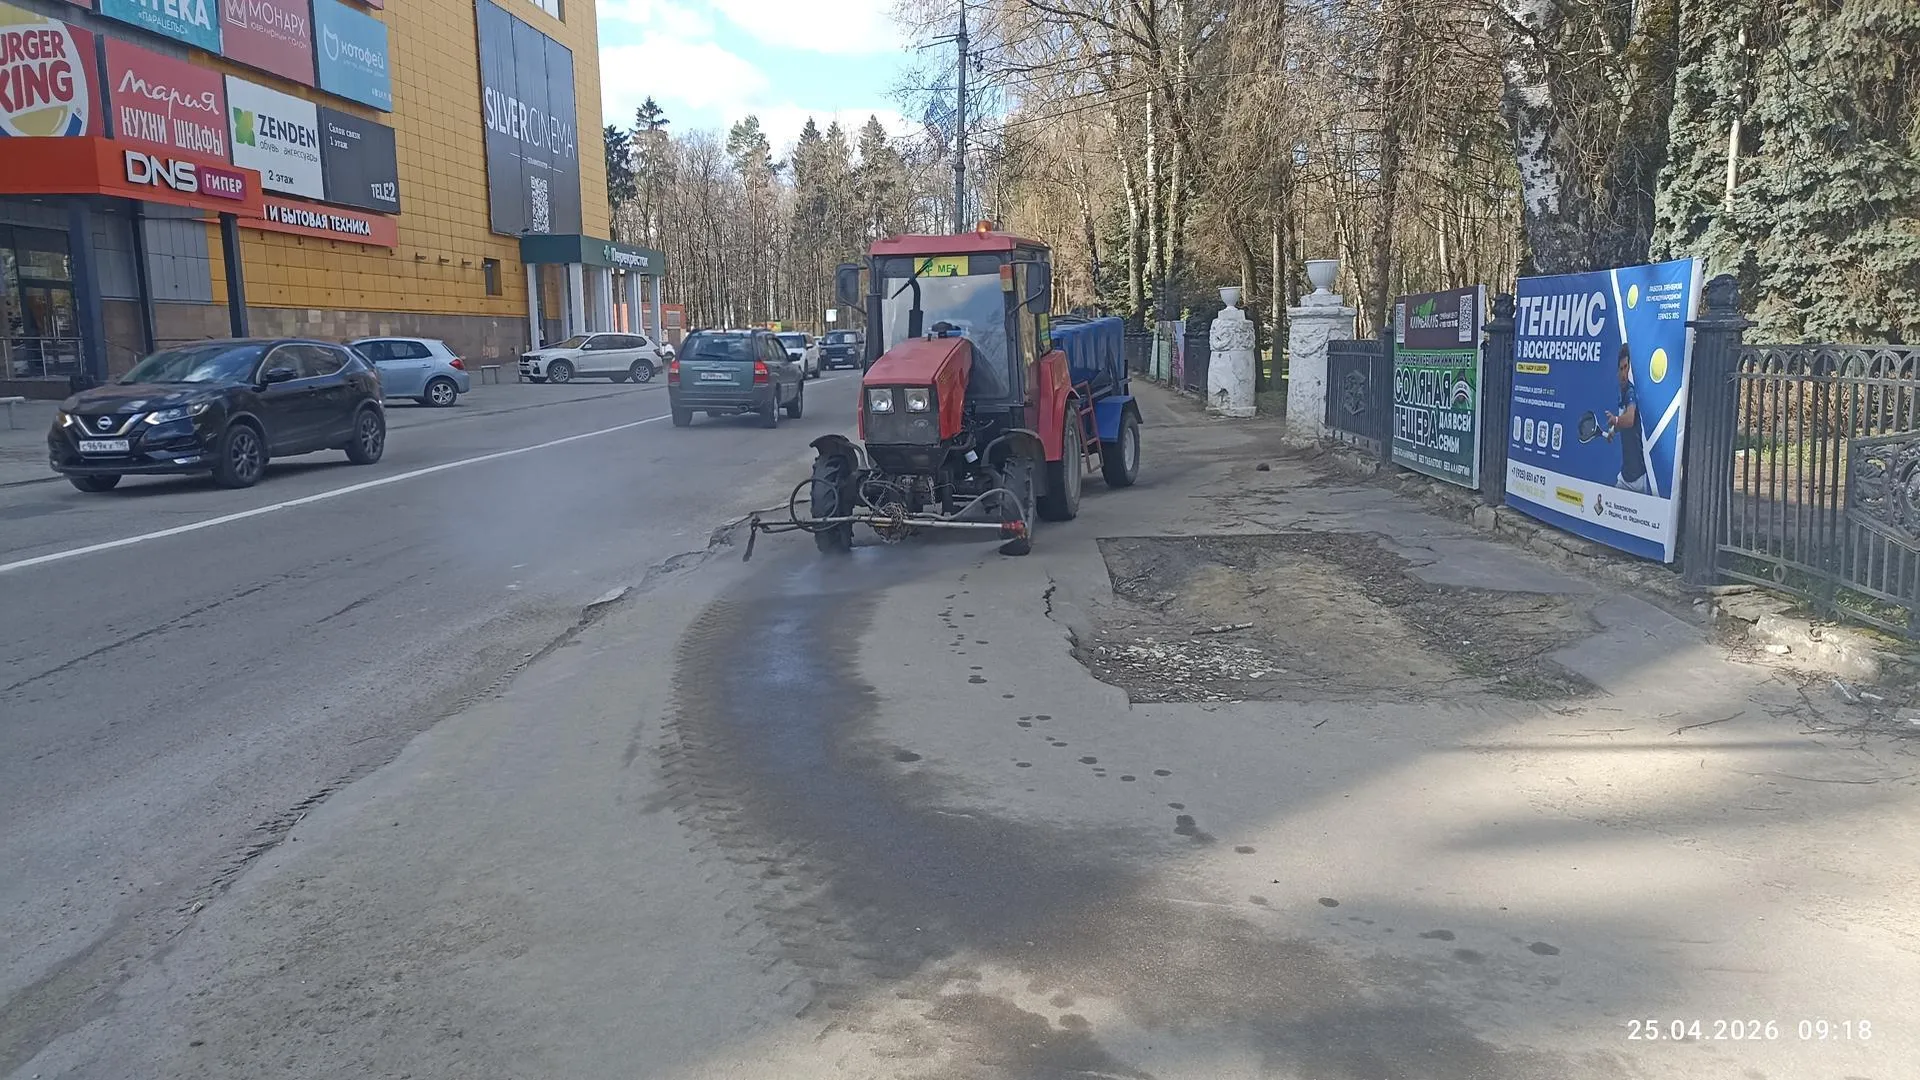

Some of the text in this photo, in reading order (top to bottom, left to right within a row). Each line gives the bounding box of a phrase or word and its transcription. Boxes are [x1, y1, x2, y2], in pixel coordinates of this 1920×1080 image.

[249, 0, 306, 38] МОНАРХ
[0, 30, 66, 66] URGER
[341, 40, 385, 69] котофей
[119, 70, 220, 120] Мария
[121, 105, 224, 157] КУХНИ ШКАФЫ
[257, 114, 317, 149] ZENDEN
[328, 122, 346, 137] Салон
[329, 136, 334, 146] 1
[259, 139, 279, 154] обувь
[125, 150, 198, 193] DNS
[204, 173, 243, 194] ГИПЕР
[268, 169, 294, 184] 2 этаж
[370, 181, 397, 203] TELE2
[269, 205, 279, 221] И
[280, 206, 329, 230] БЫТОВАЯ
[329, 215, 372, 236] ТЕХНИКА
[1519, 291, 1607, 337] ТЕННИС
[1517, 340, 1601, 362] В ВОСКРЕСЕНСКЕ
[1394, 367, 1452, 410] СОЛЯНАЯ
[1393, 404, 1439, 449] ПЕЩЕРА
[1439, 410, 1471, 432] ДЛЯ ВСЕЙ
[1439, 434, 1460, 454] СЕМЬИ
